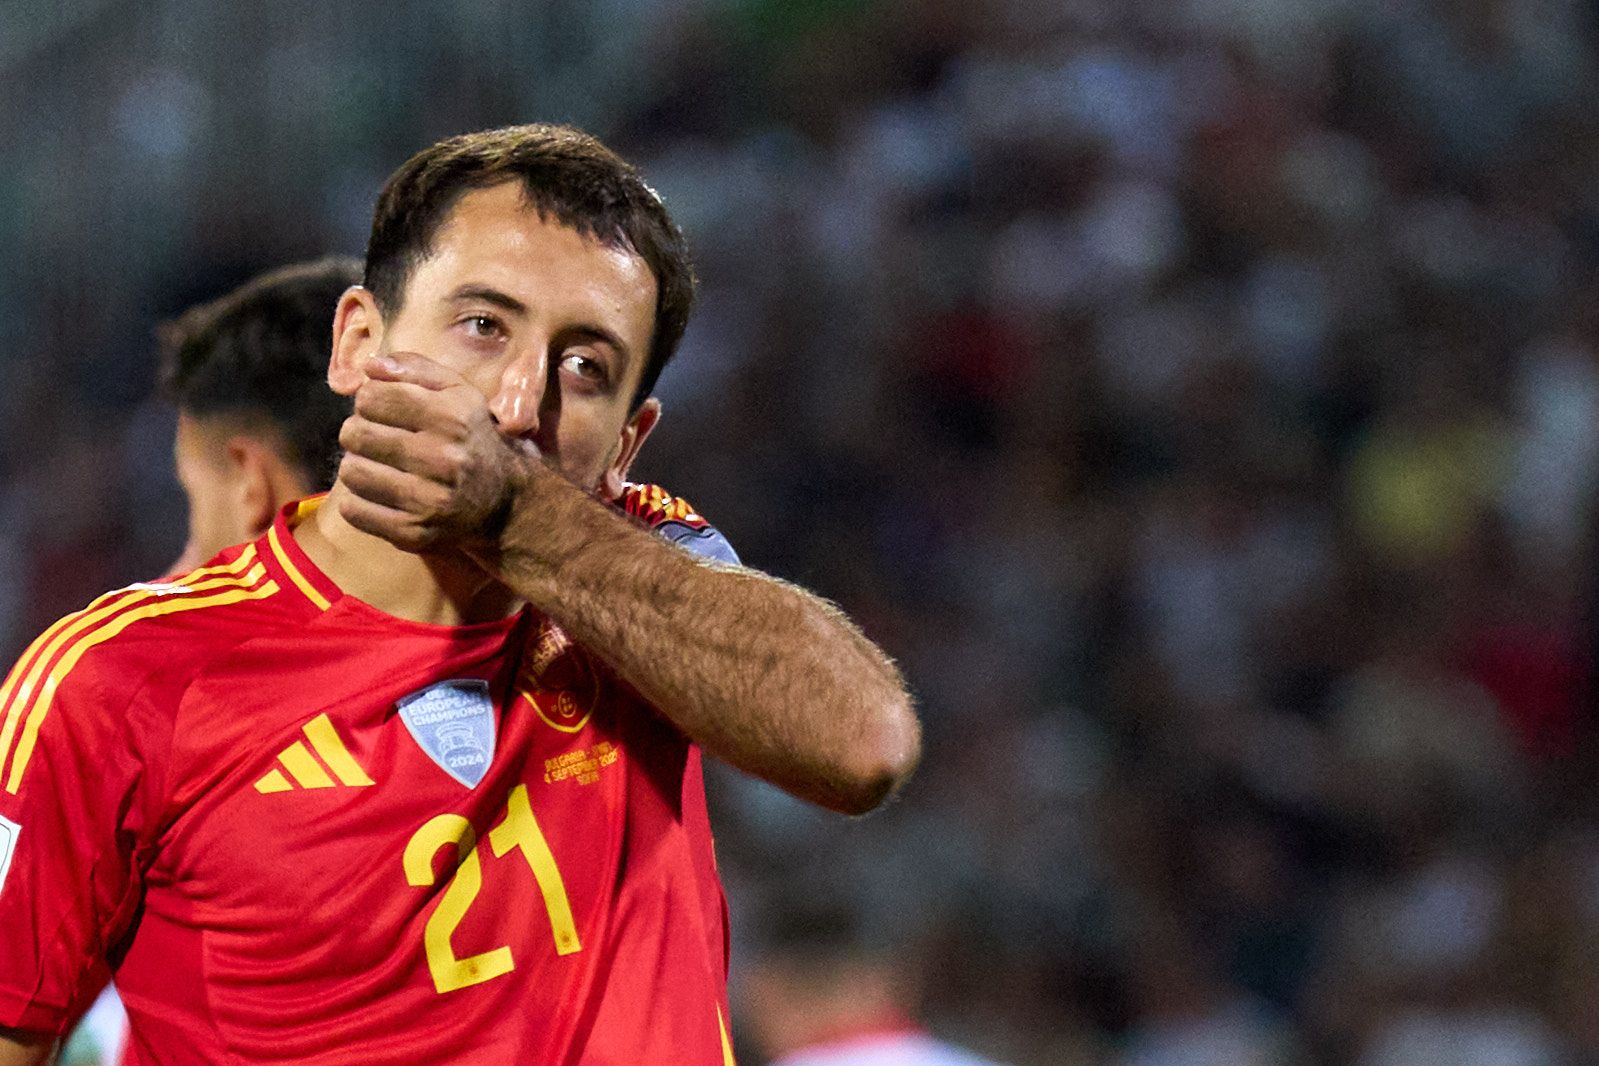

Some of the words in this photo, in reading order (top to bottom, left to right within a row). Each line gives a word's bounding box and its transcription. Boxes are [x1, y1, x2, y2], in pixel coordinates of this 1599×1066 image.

[412, 703, 486, 726] CHAMPIONS
[449, 753, 484, 768] 2024
[403, 784, 582, 994] 21
